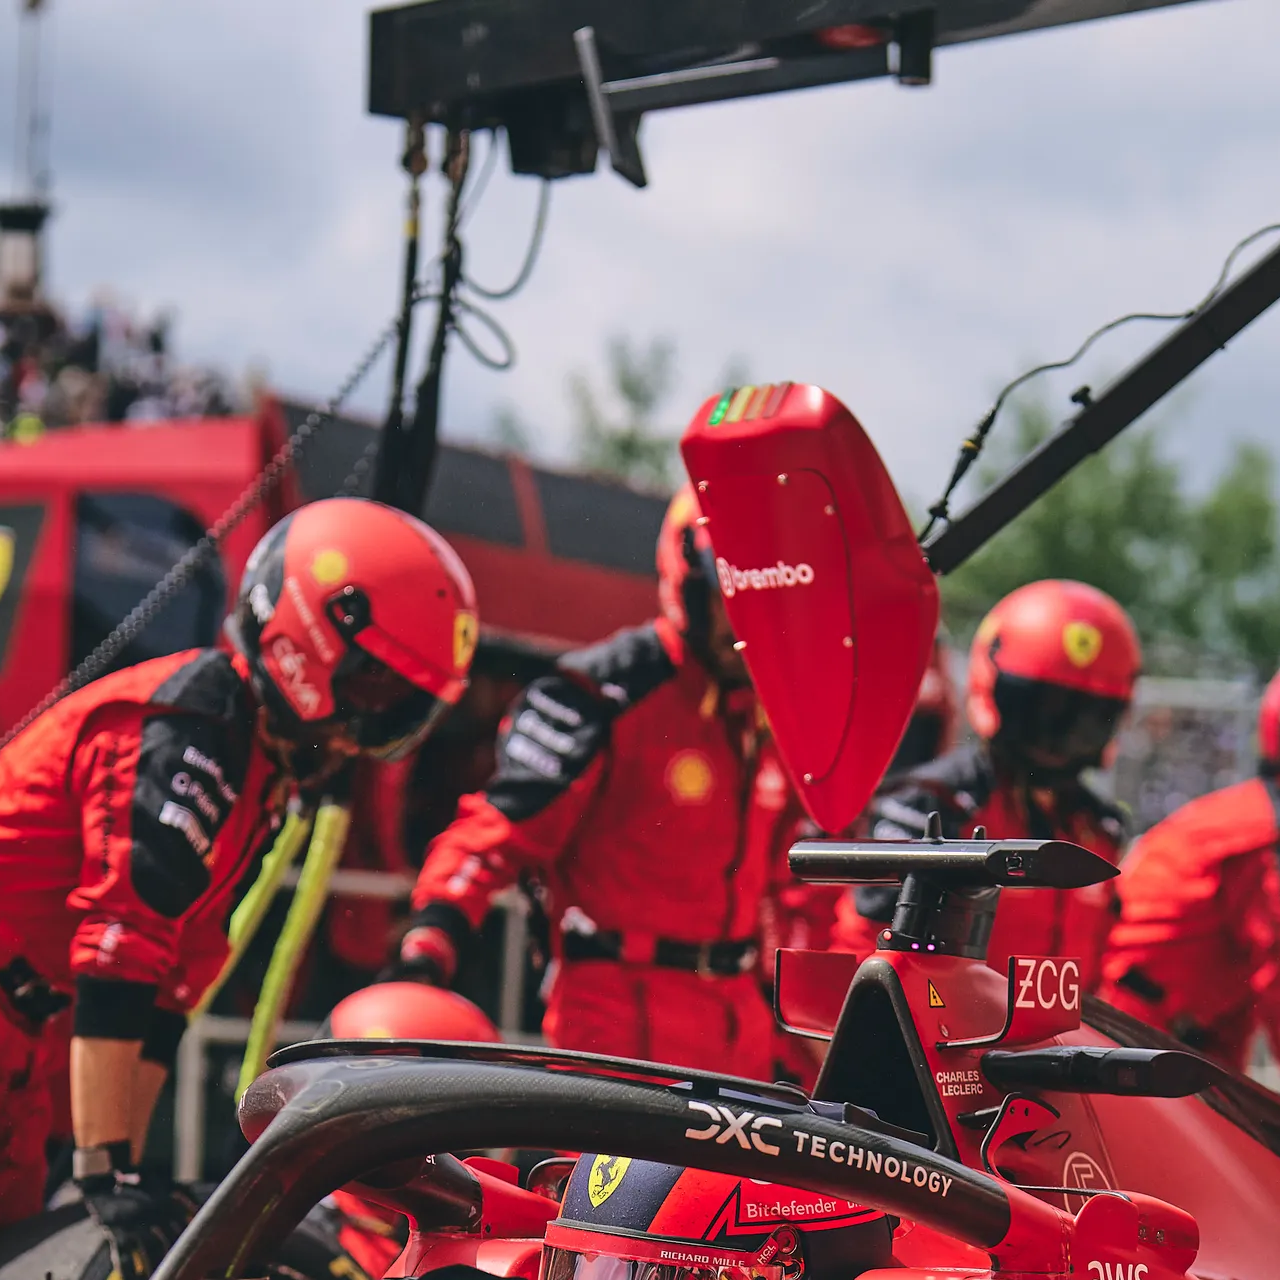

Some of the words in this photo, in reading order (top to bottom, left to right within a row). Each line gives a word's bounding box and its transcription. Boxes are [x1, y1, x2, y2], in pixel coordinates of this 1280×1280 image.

[731, 560, 815, 591] brembo
[936, 1070, 980, 1083] CHARLES
[942, 1083, 983, 1097] LECLERC
[685, 1100, 783, 1156] DXC
[792, 1130, 953, 1197] TECHNOLOGY
[746, 1198, 837, 1219] Bitdefender
[660, 1250, 710, 1264] RICHARD
[712, 1256, 745, 1268] MILLE
